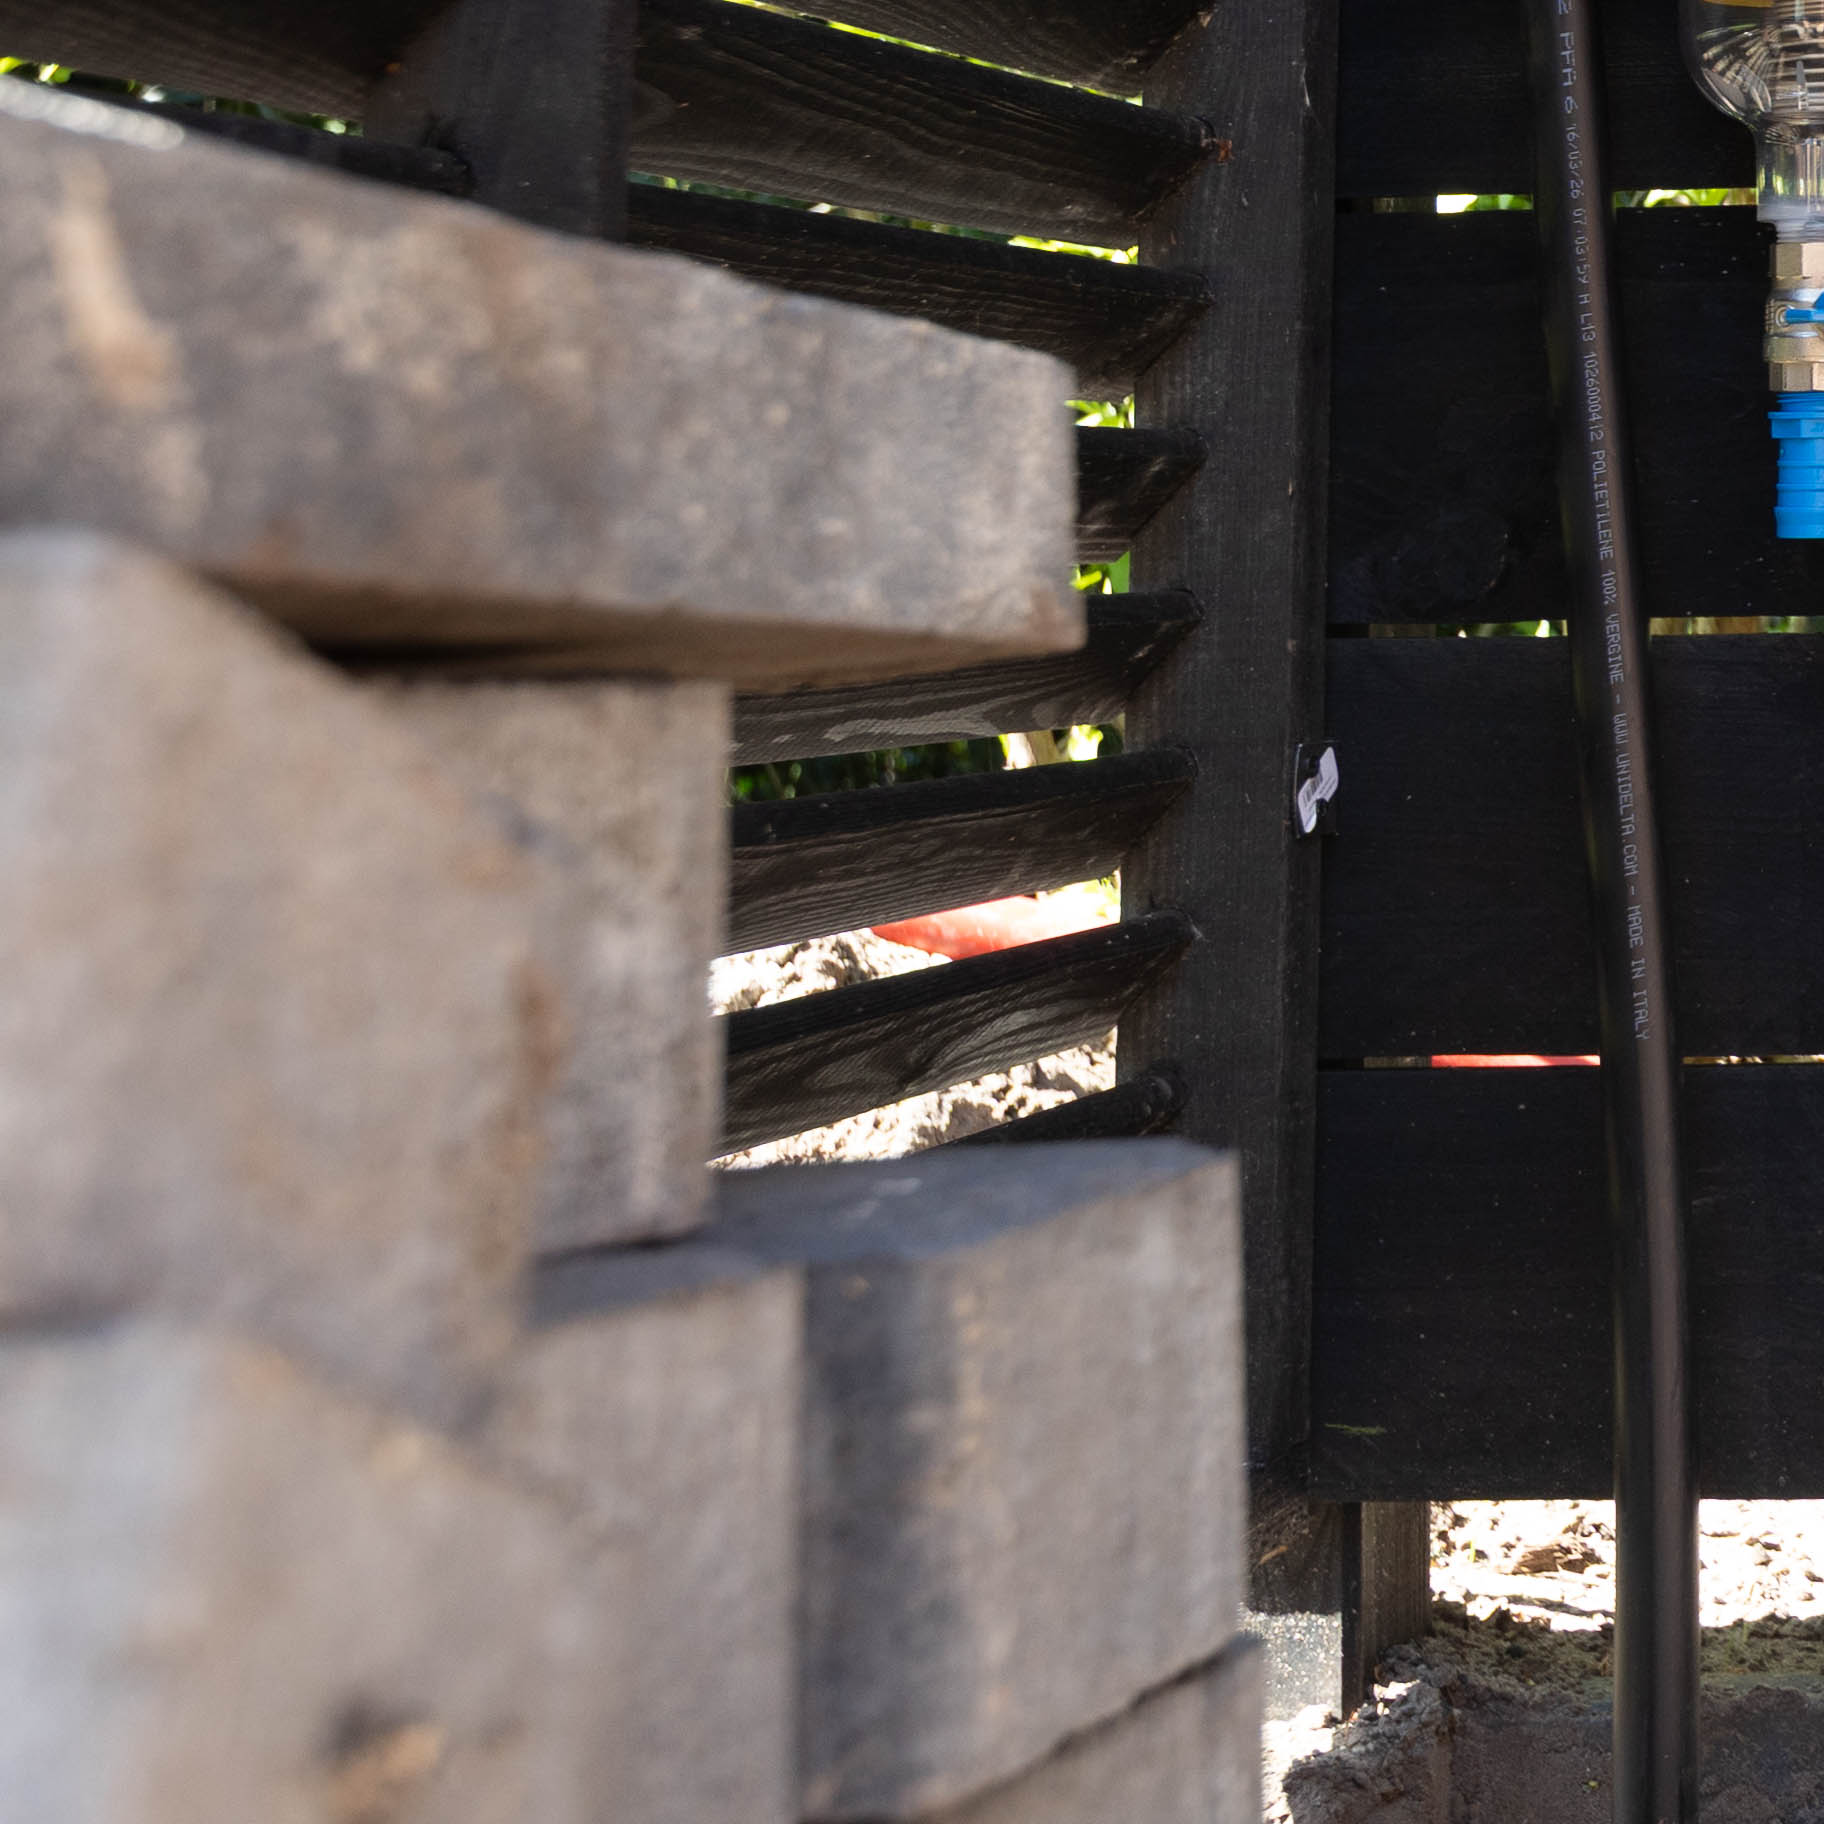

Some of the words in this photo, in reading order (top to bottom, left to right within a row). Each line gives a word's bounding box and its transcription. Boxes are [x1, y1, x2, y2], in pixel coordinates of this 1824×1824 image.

[1591, 449, 1615, 561] POLIETILENE
[1601, 568, 1617, 605] 100%
[1605, 613, 1625, 685] VERGINE
[1612, 712, 1640, 877] WWW.UNIDELTA.COM
[1626, 905, 1645, 949] MADE
[1631, 958, 1648, 980] IN
[1633, 989, 1651, 1041] ITALY
